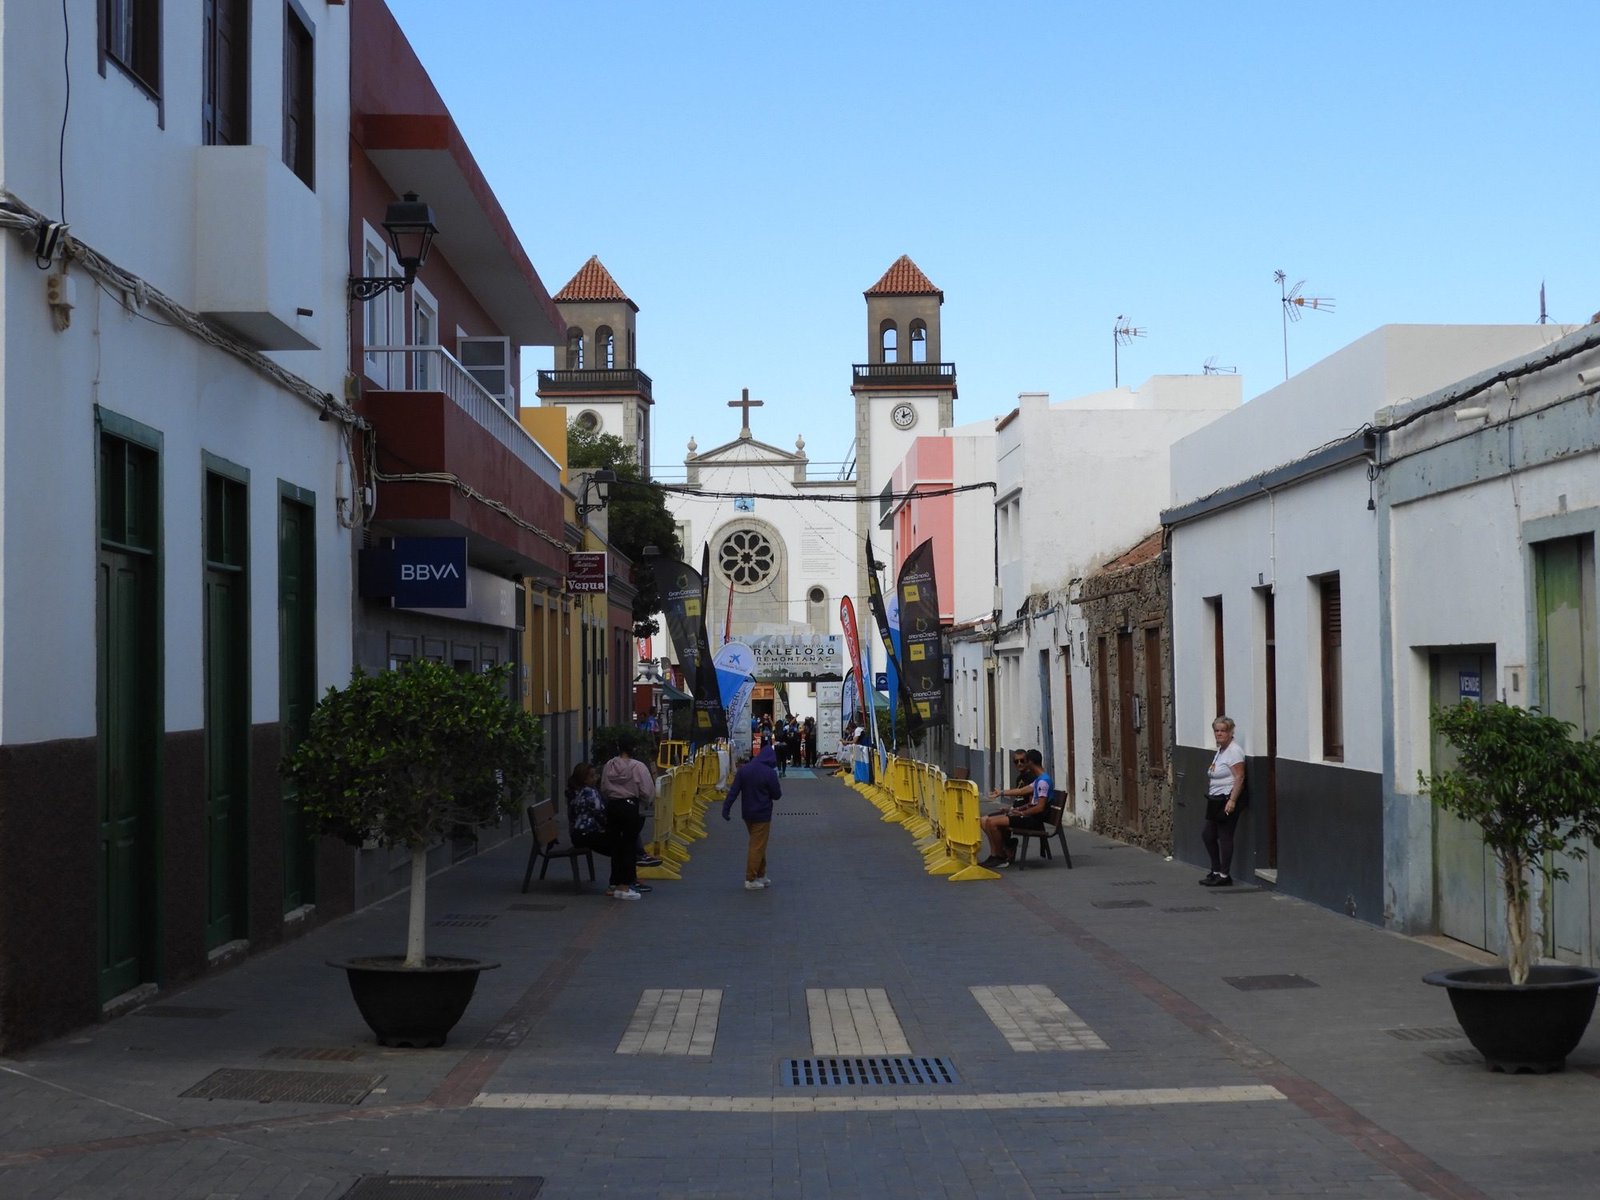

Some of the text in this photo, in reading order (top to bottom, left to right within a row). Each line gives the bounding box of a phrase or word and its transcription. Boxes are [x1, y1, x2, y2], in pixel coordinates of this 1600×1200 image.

[401, 562, 460, 581] BBVA
[567, 580, 605, 591] Venus
[753, 648, 836, 656] RALELO28
[1461, 676, 1480, 692] VENDE
